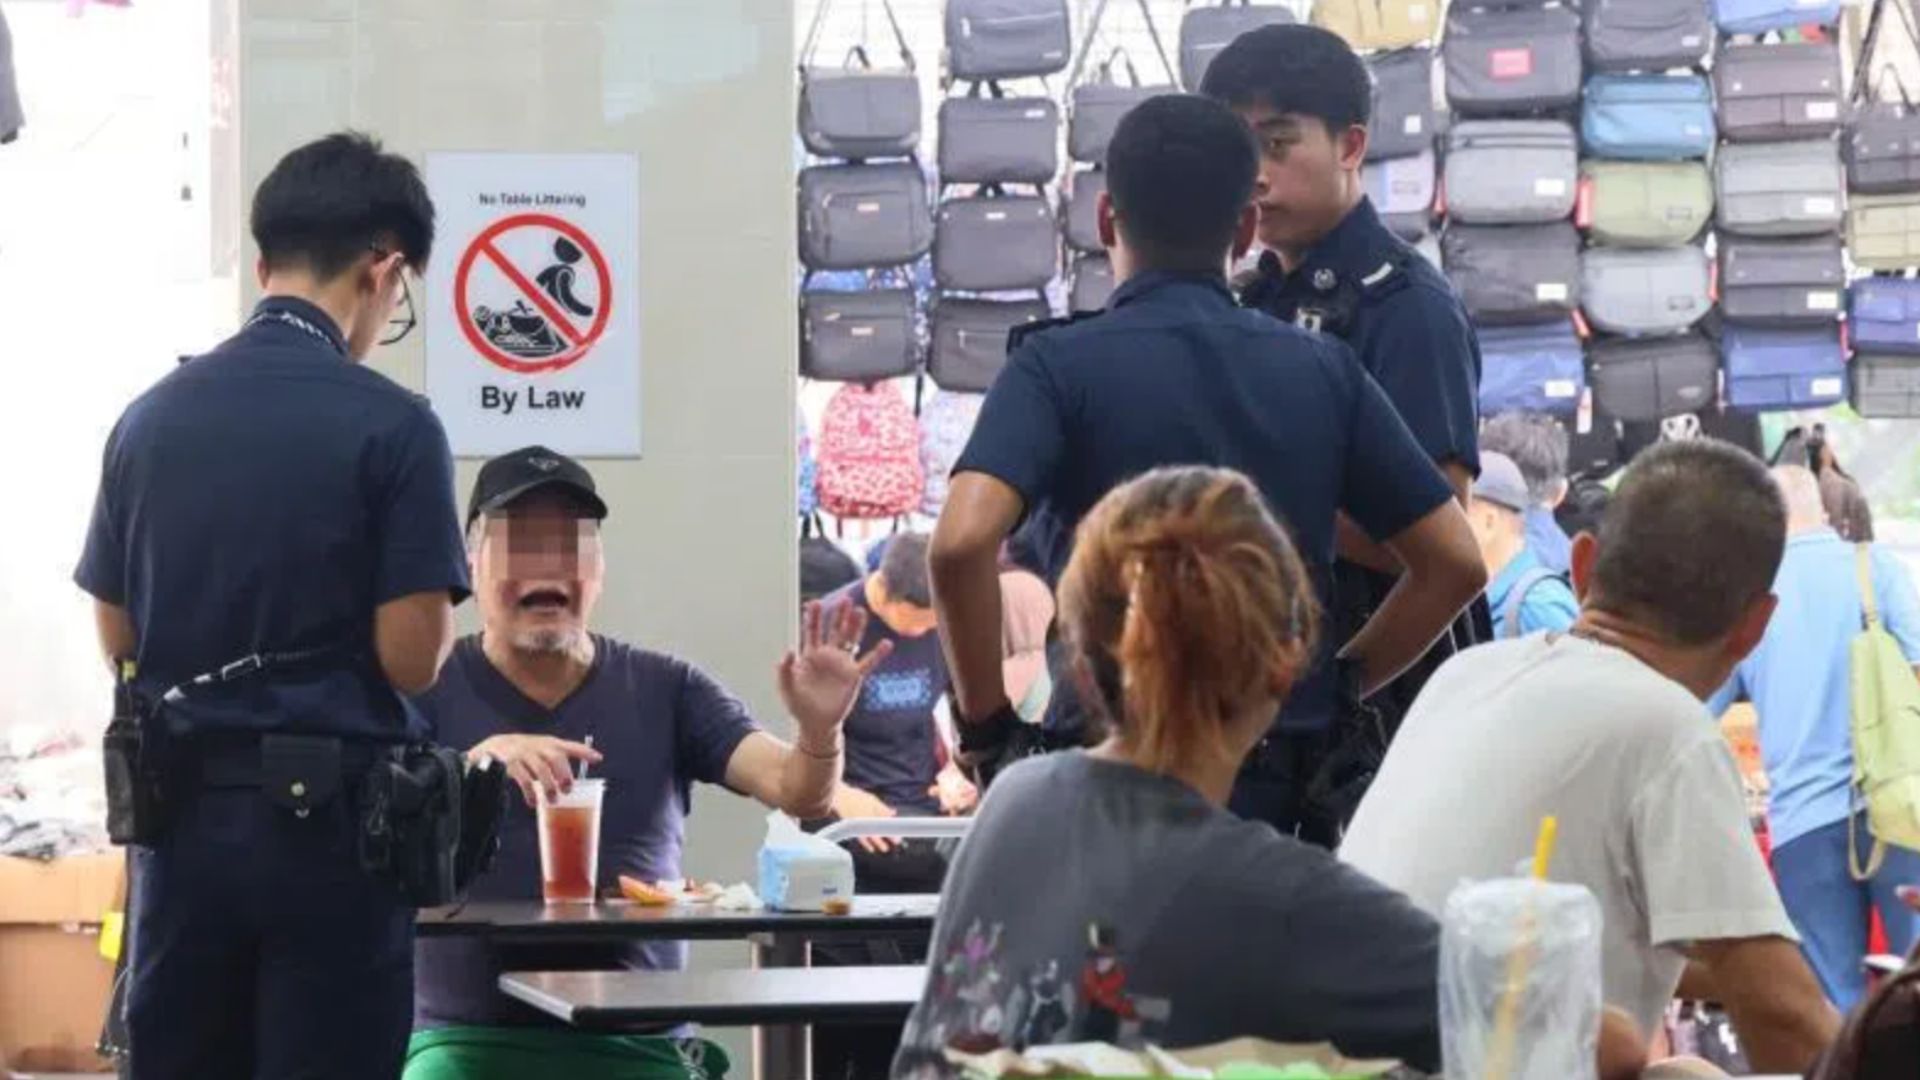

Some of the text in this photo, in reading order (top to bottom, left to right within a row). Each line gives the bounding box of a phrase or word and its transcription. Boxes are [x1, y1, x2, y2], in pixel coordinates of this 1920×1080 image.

[479, 192, 586, 208] No Table Littering
[481, 385, 586, 414] By Law
